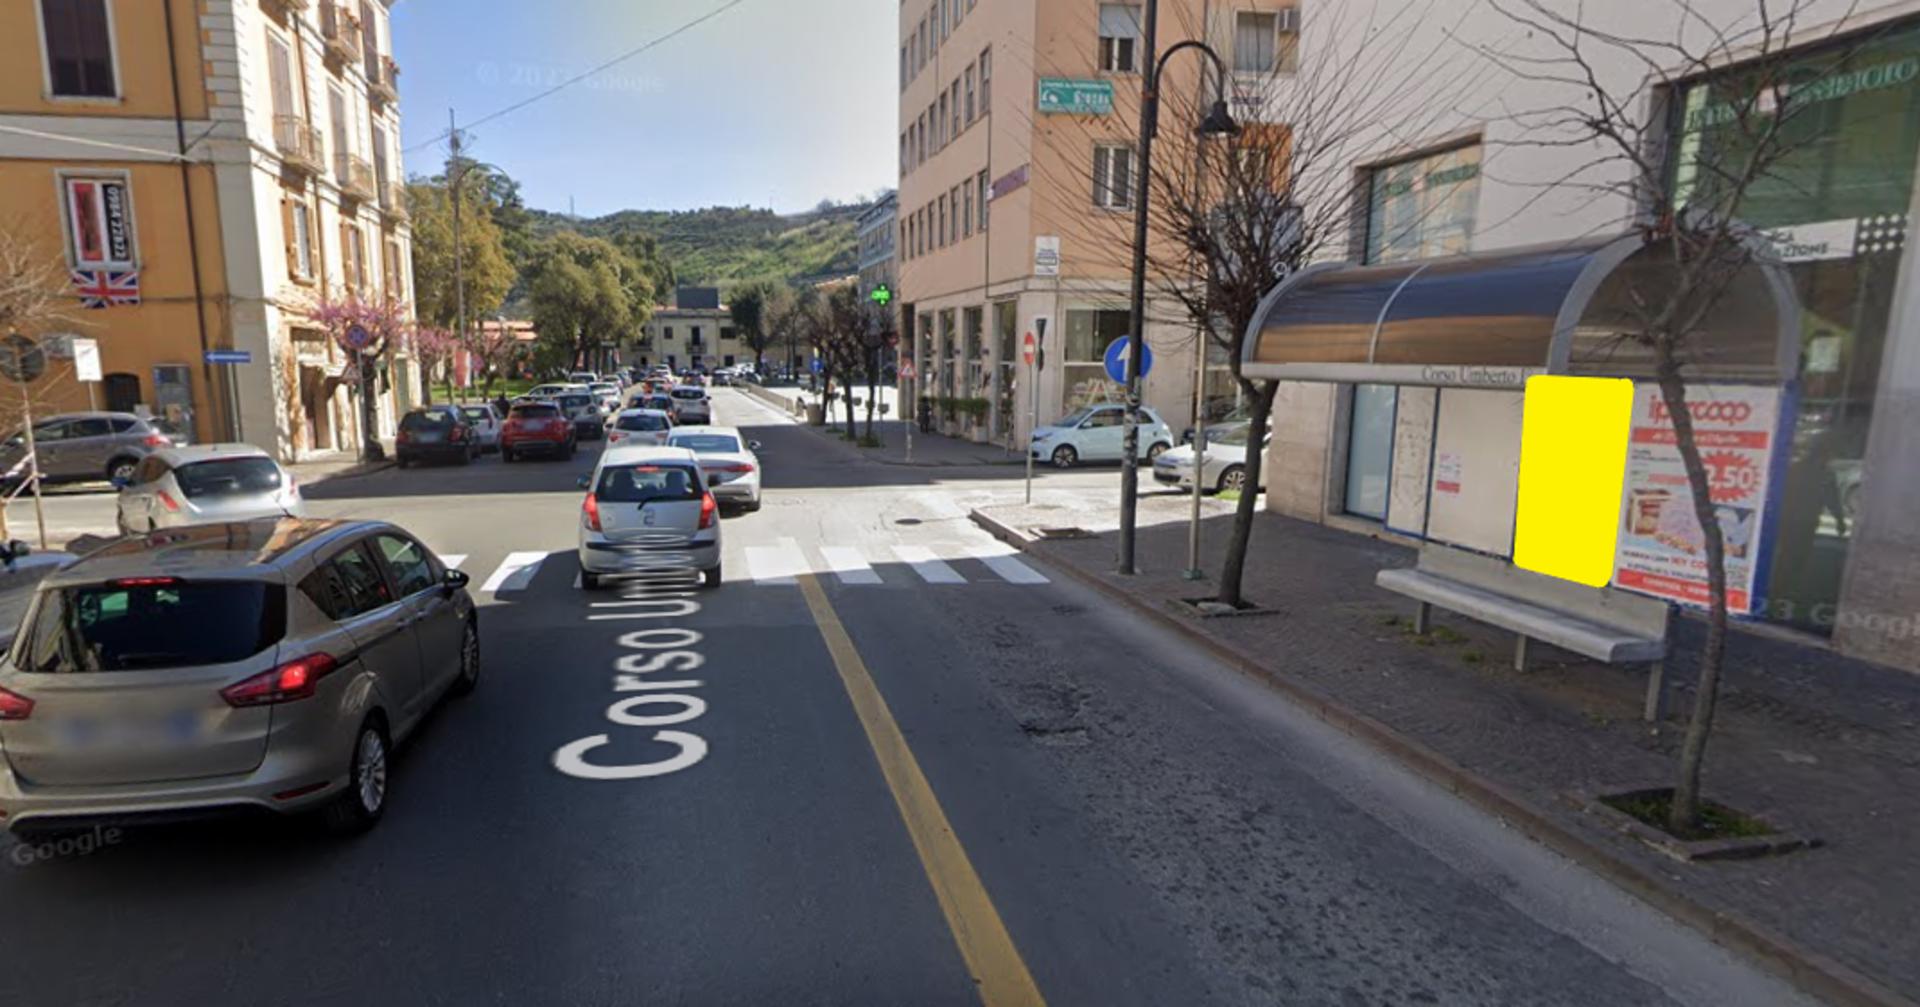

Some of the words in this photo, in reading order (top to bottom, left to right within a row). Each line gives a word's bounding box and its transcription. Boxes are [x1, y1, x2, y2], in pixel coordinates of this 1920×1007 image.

[1422, 365, 1455, 381] Corso
[1460, 365, 1515, 383] Umberto
[1648, 394, 1752, 426] iprcoop
